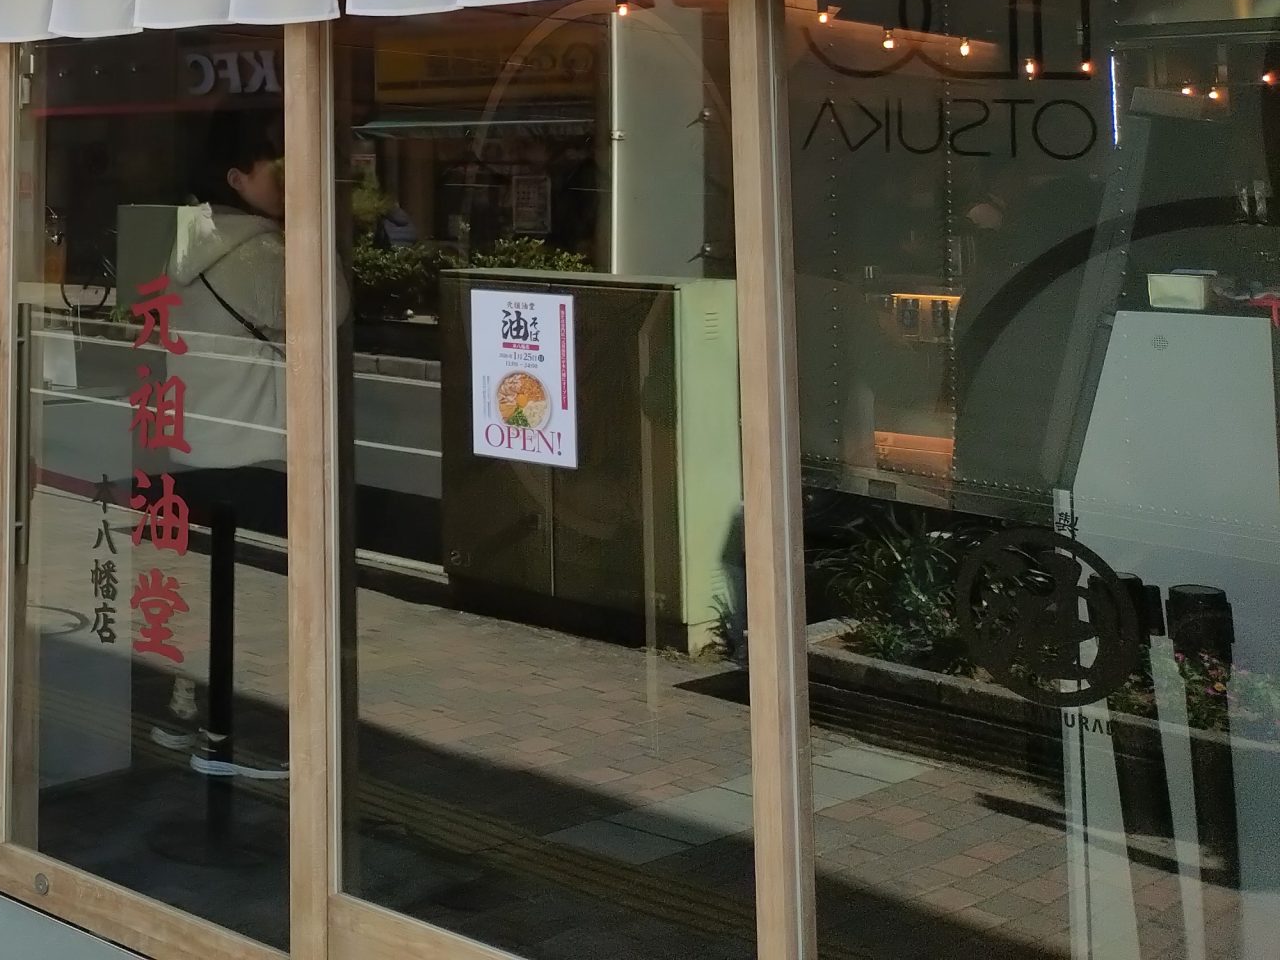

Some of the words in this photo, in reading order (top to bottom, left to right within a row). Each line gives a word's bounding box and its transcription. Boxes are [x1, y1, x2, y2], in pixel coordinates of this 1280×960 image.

[130, 272, 192, 664] 元祖油堂
[485, 423, 562, 456] OPEN!
[90, 474, 119, 645] 本八幡店
